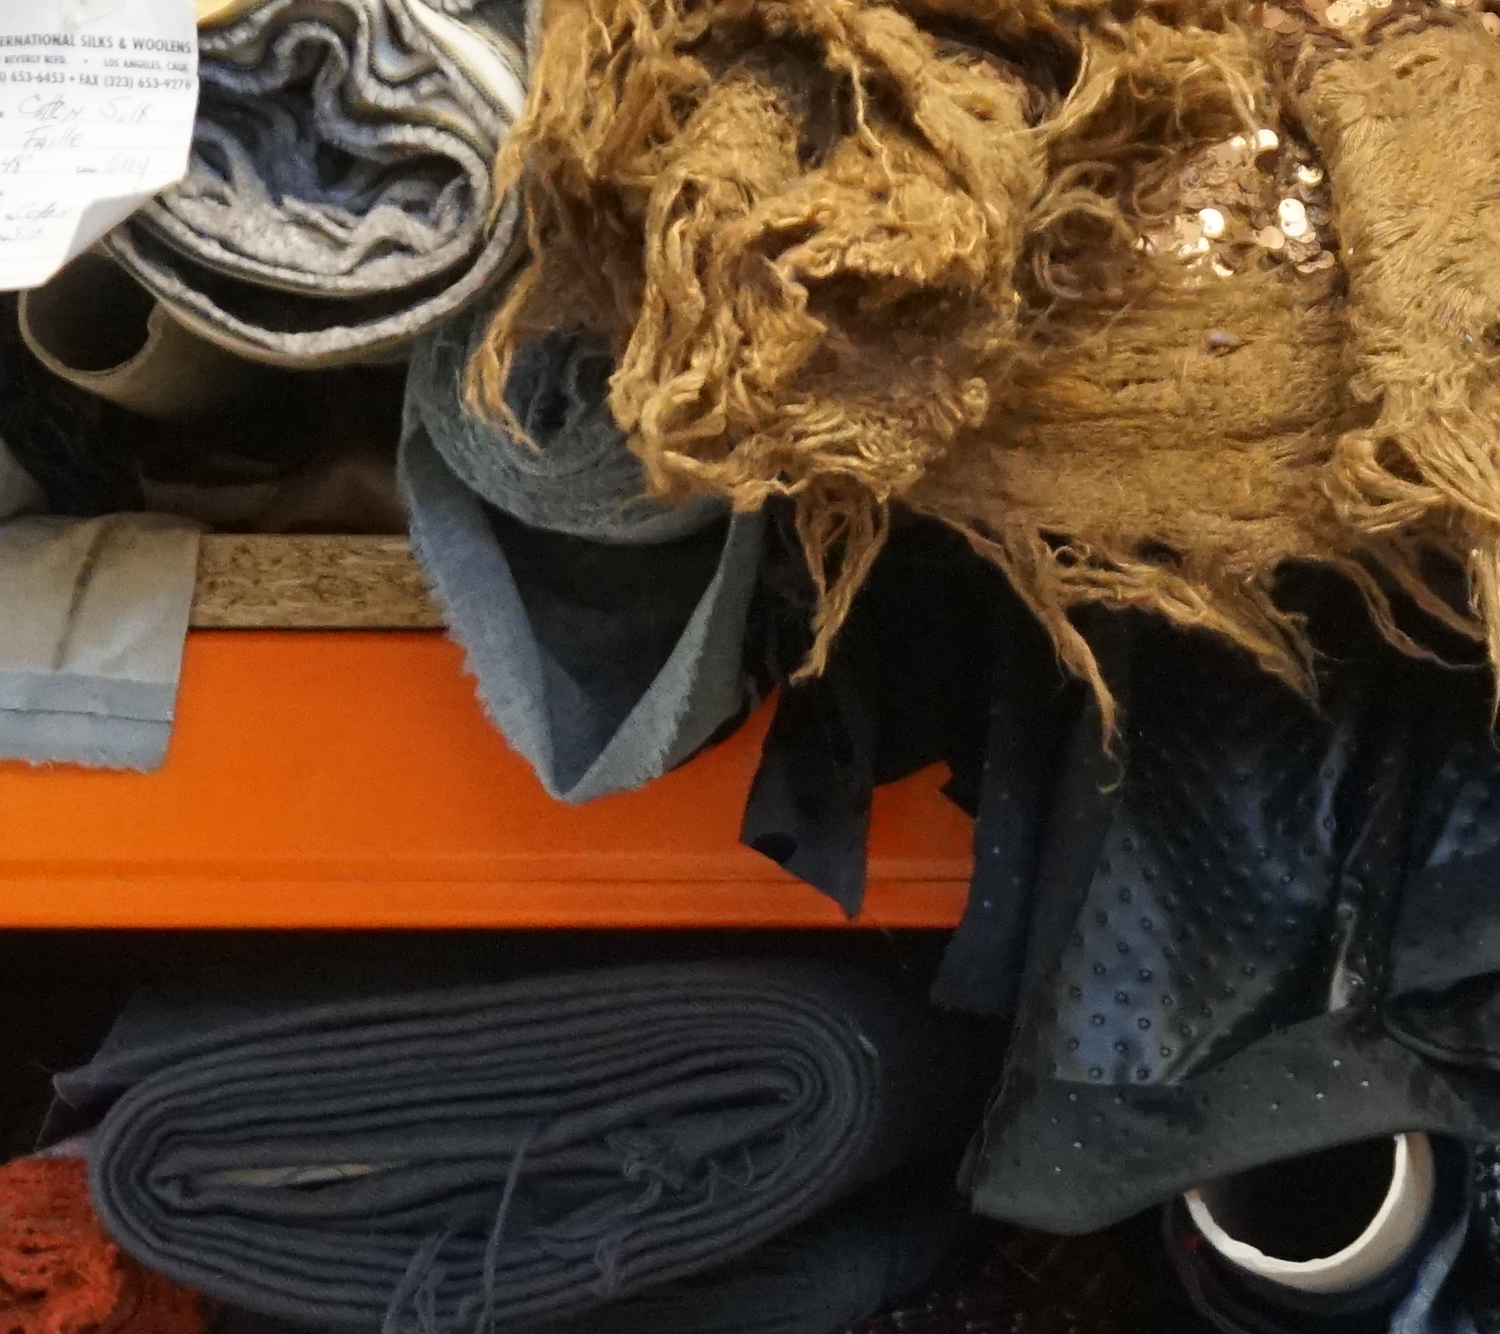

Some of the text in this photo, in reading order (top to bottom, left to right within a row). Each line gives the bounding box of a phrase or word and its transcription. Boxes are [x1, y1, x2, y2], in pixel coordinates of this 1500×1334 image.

[81, 34, 114, 48] SILKS
[119, 36, 127, 49] &
[132, 37, 192, 54] WOOLENS
[103, 58, 119, 68] LOS
[10, 70, 66, 84] 653-6453
[79, 73, 99, 86] FAX
[103, 75, 134, 89] (323)
[138, 77, 192, 90] 653-9276
